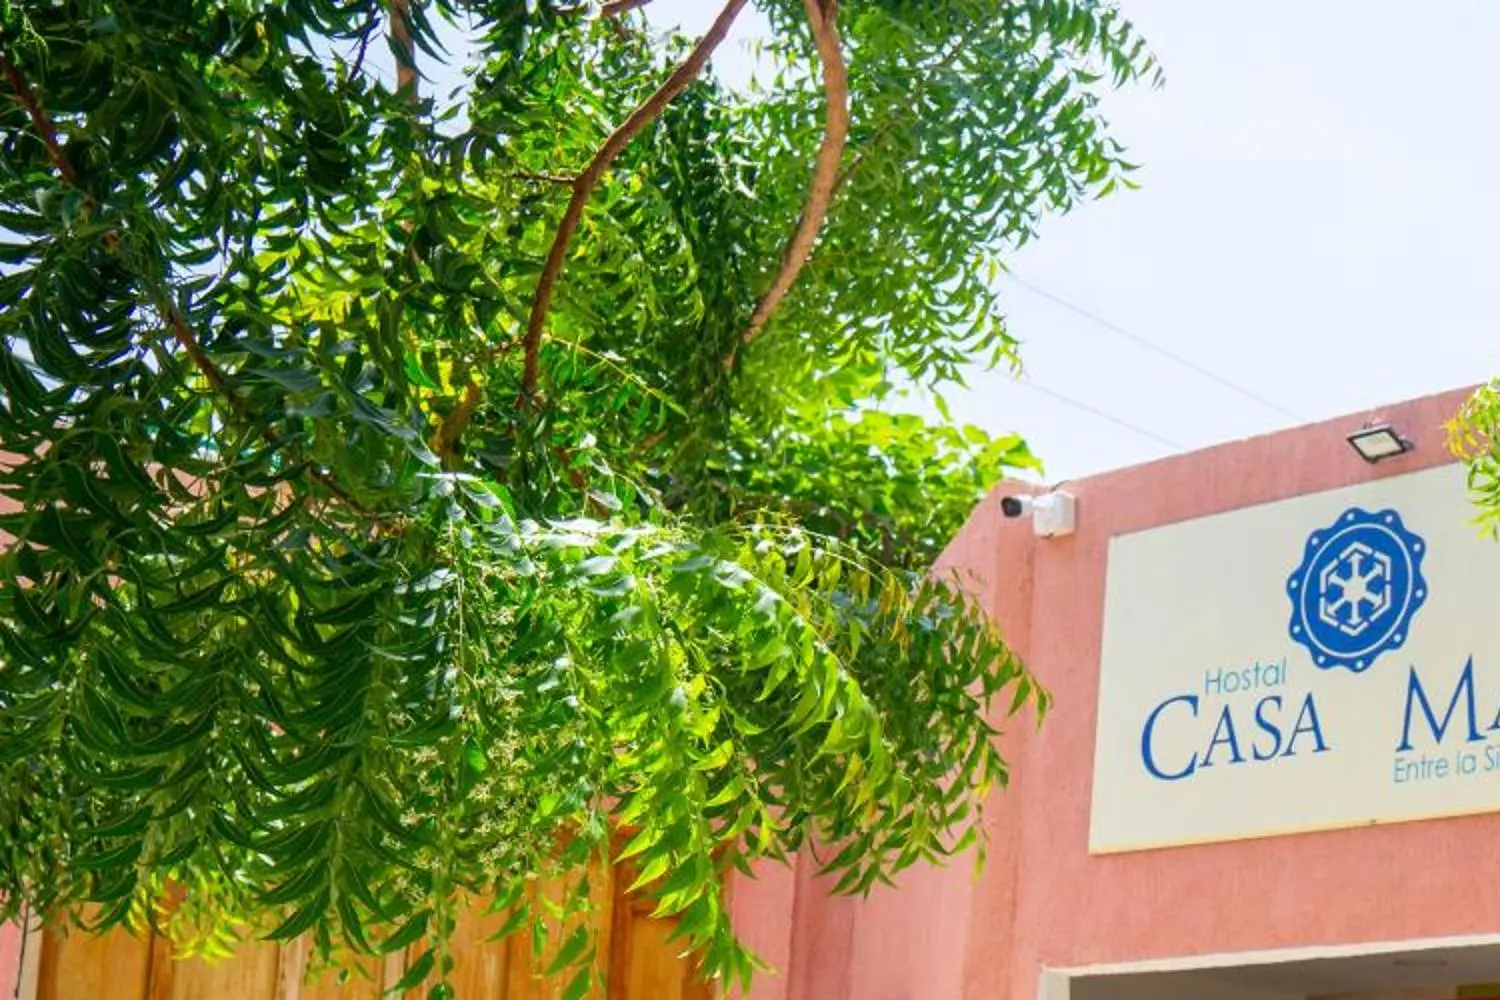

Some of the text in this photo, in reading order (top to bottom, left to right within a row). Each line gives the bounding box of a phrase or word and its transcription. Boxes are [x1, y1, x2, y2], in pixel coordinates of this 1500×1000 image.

[1204, 656, 1288, 696] Hostal
[1140, 691, 1332, 781] CASA
[1393, 753, 1449, 784] Entre
[1456, 750, 1477, 775] la
